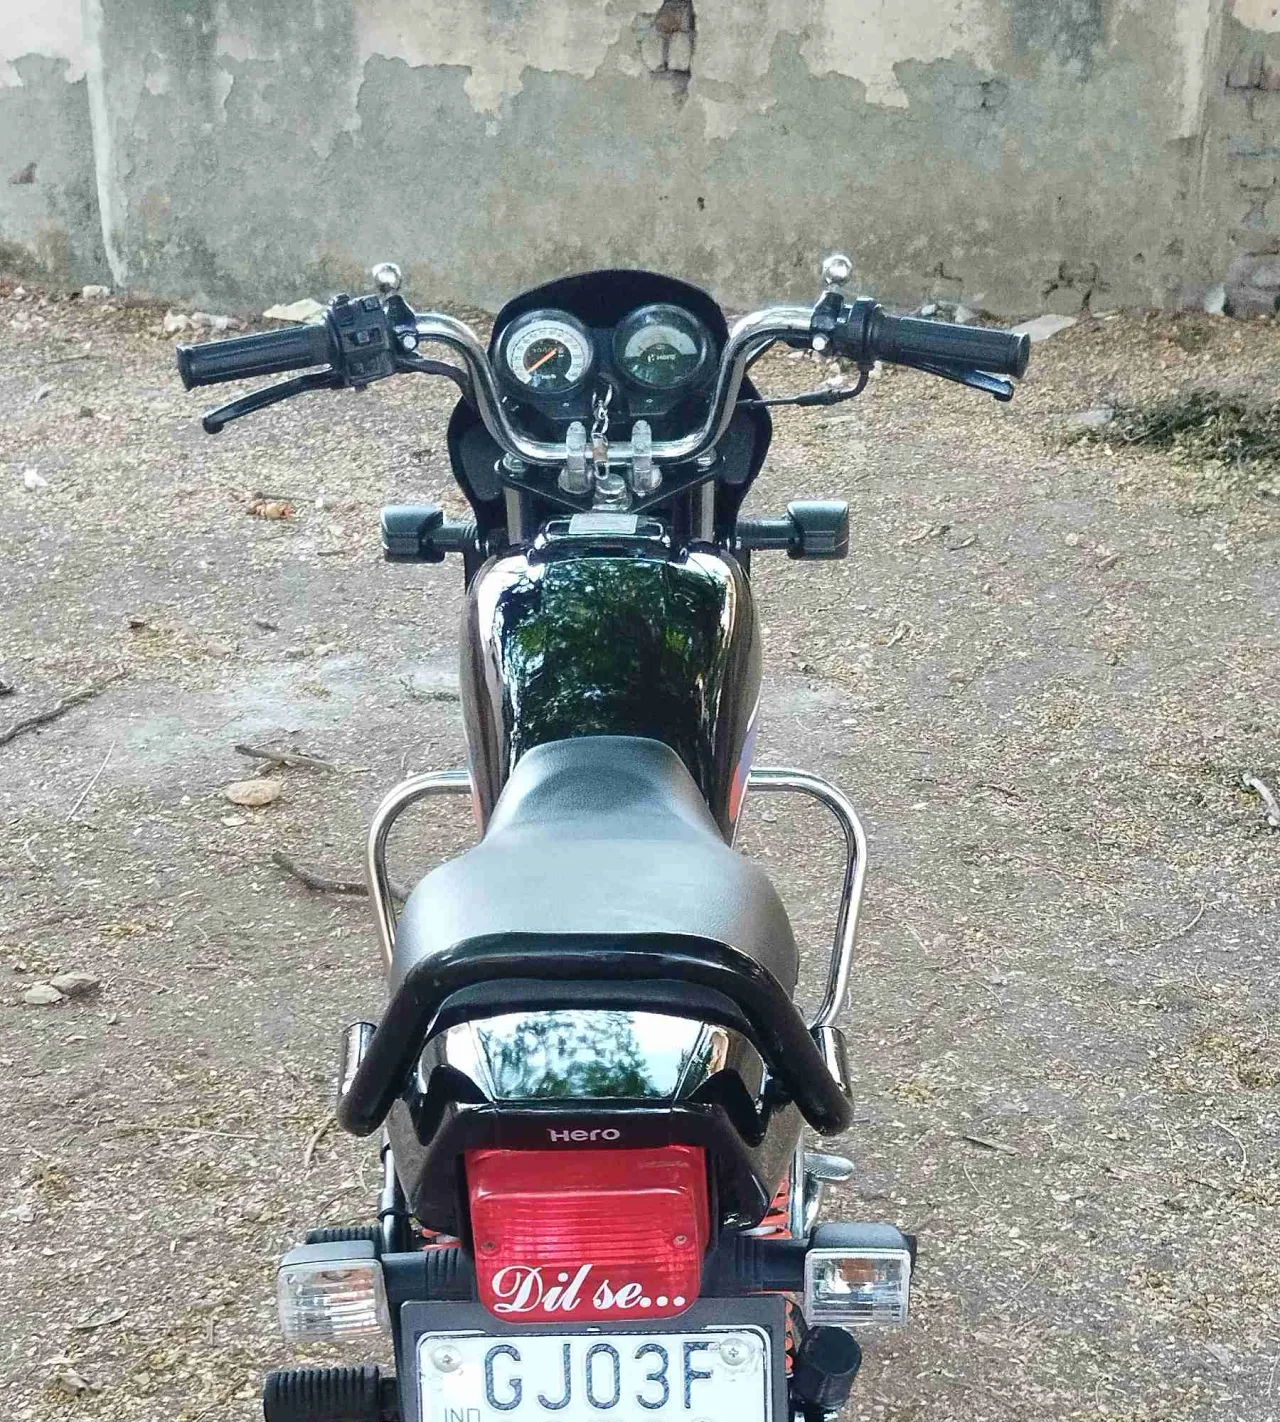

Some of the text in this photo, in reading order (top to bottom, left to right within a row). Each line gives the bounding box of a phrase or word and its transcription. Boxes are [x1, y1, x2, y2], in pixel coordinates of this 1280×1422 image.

[547, 1127, 620, 1142] Hero
[492, 1263, 593, 1313] Dil
[483, 1342, 715, 1410] GJ03F
